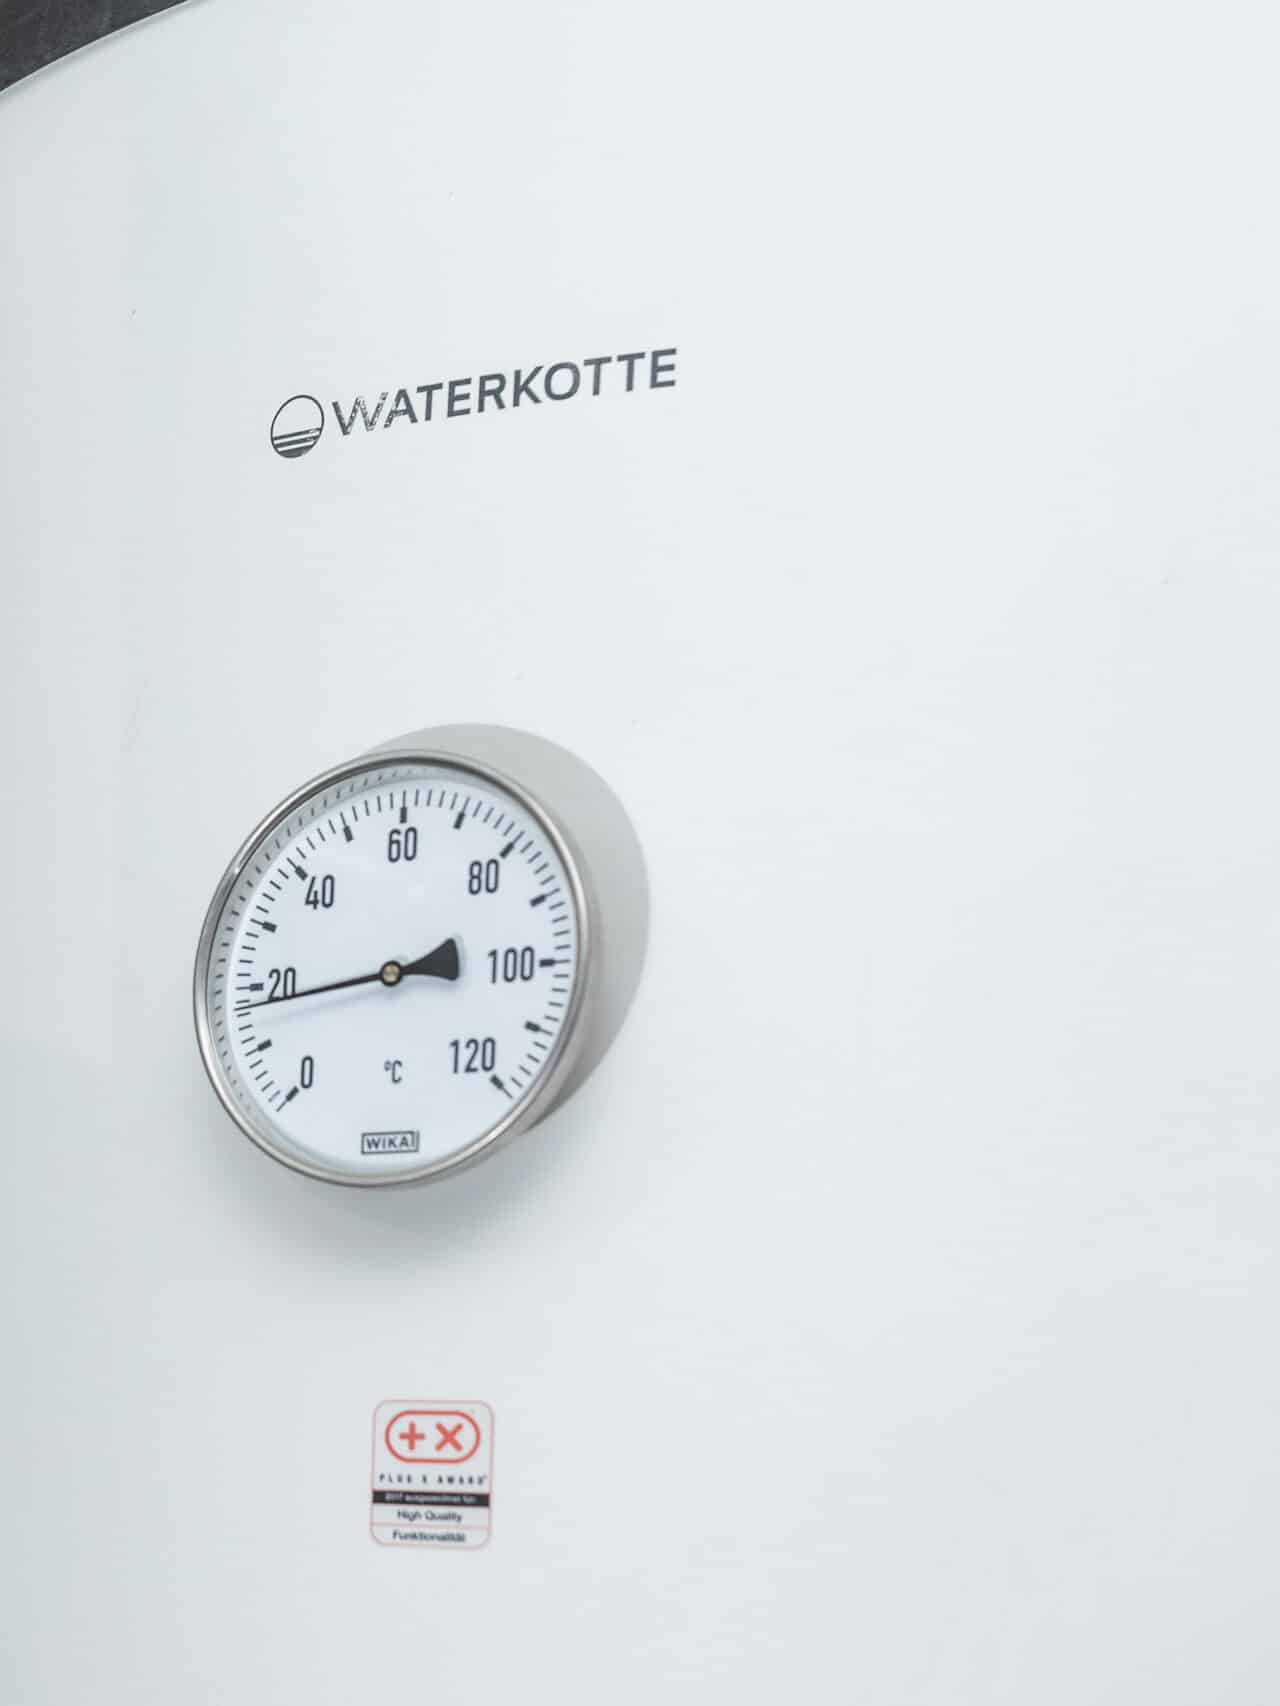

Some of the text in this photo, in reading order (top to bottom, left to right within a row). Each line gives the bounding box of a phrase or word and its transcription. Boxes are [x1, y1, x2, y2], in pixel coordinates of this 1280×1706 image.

[332, 348, 677, 436] WATERKOTTE
[387, 827, 417, 862] 60
[304, 875, 335, 910] 40
[469, 859, 500, 895] 80
[488, 946, 534, 984] 100
[268, 967, 296, 1001] 20
[300, 1056, 314, 1089] 0
[384, 1060, 403, 1084] °C
[449, 1037, 496, 1074] 120
[366, 1136, 409, 1149] WIKA
[397, 1509, 462, 1522] High Quality
